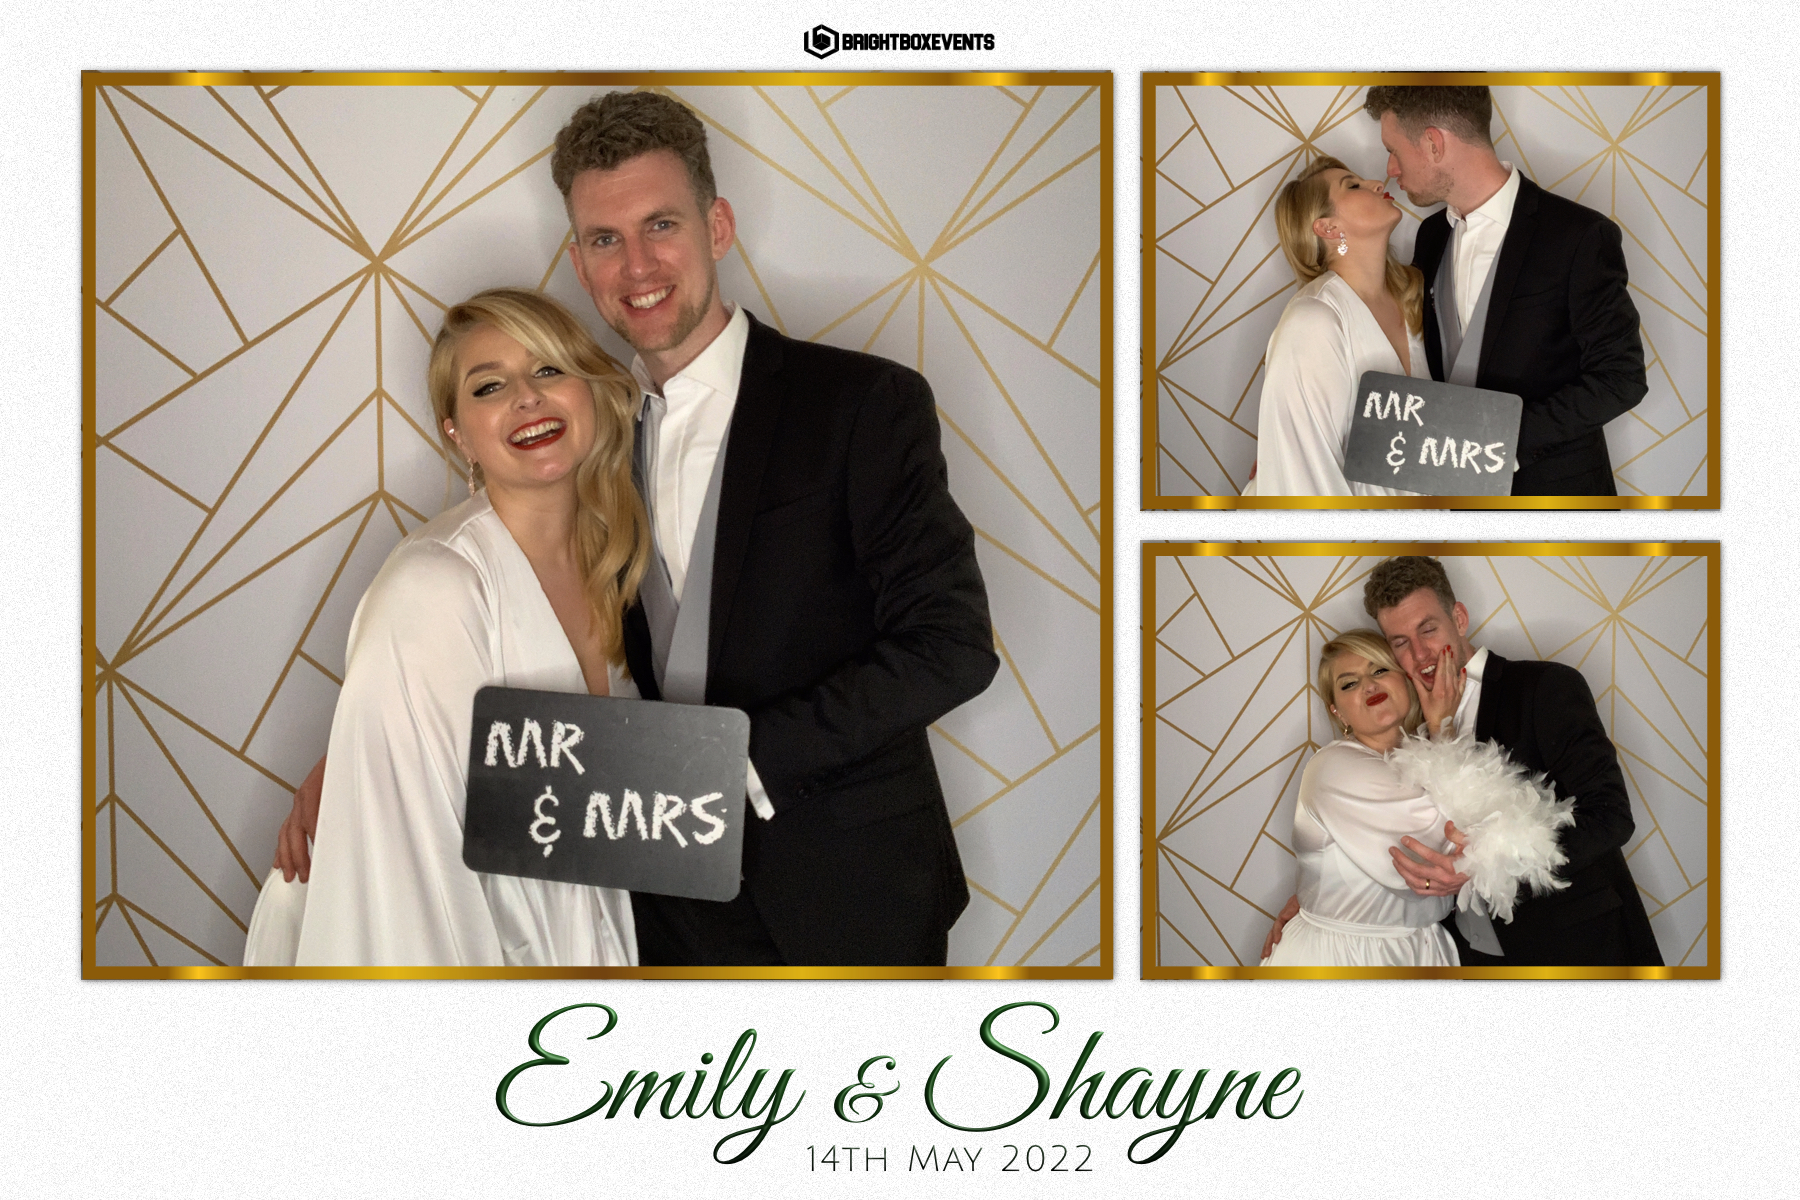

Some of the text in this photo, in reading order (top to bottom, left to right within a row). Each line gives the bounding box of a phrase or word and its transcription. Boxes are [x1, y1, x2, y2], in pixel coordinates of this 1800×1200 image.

[1362, 390, 1426, 427] MR
[1385, 431, 1507, 476] & MRS
[484, 717, 586, 776] MR
[527, 785, 728, 858] & MRS
